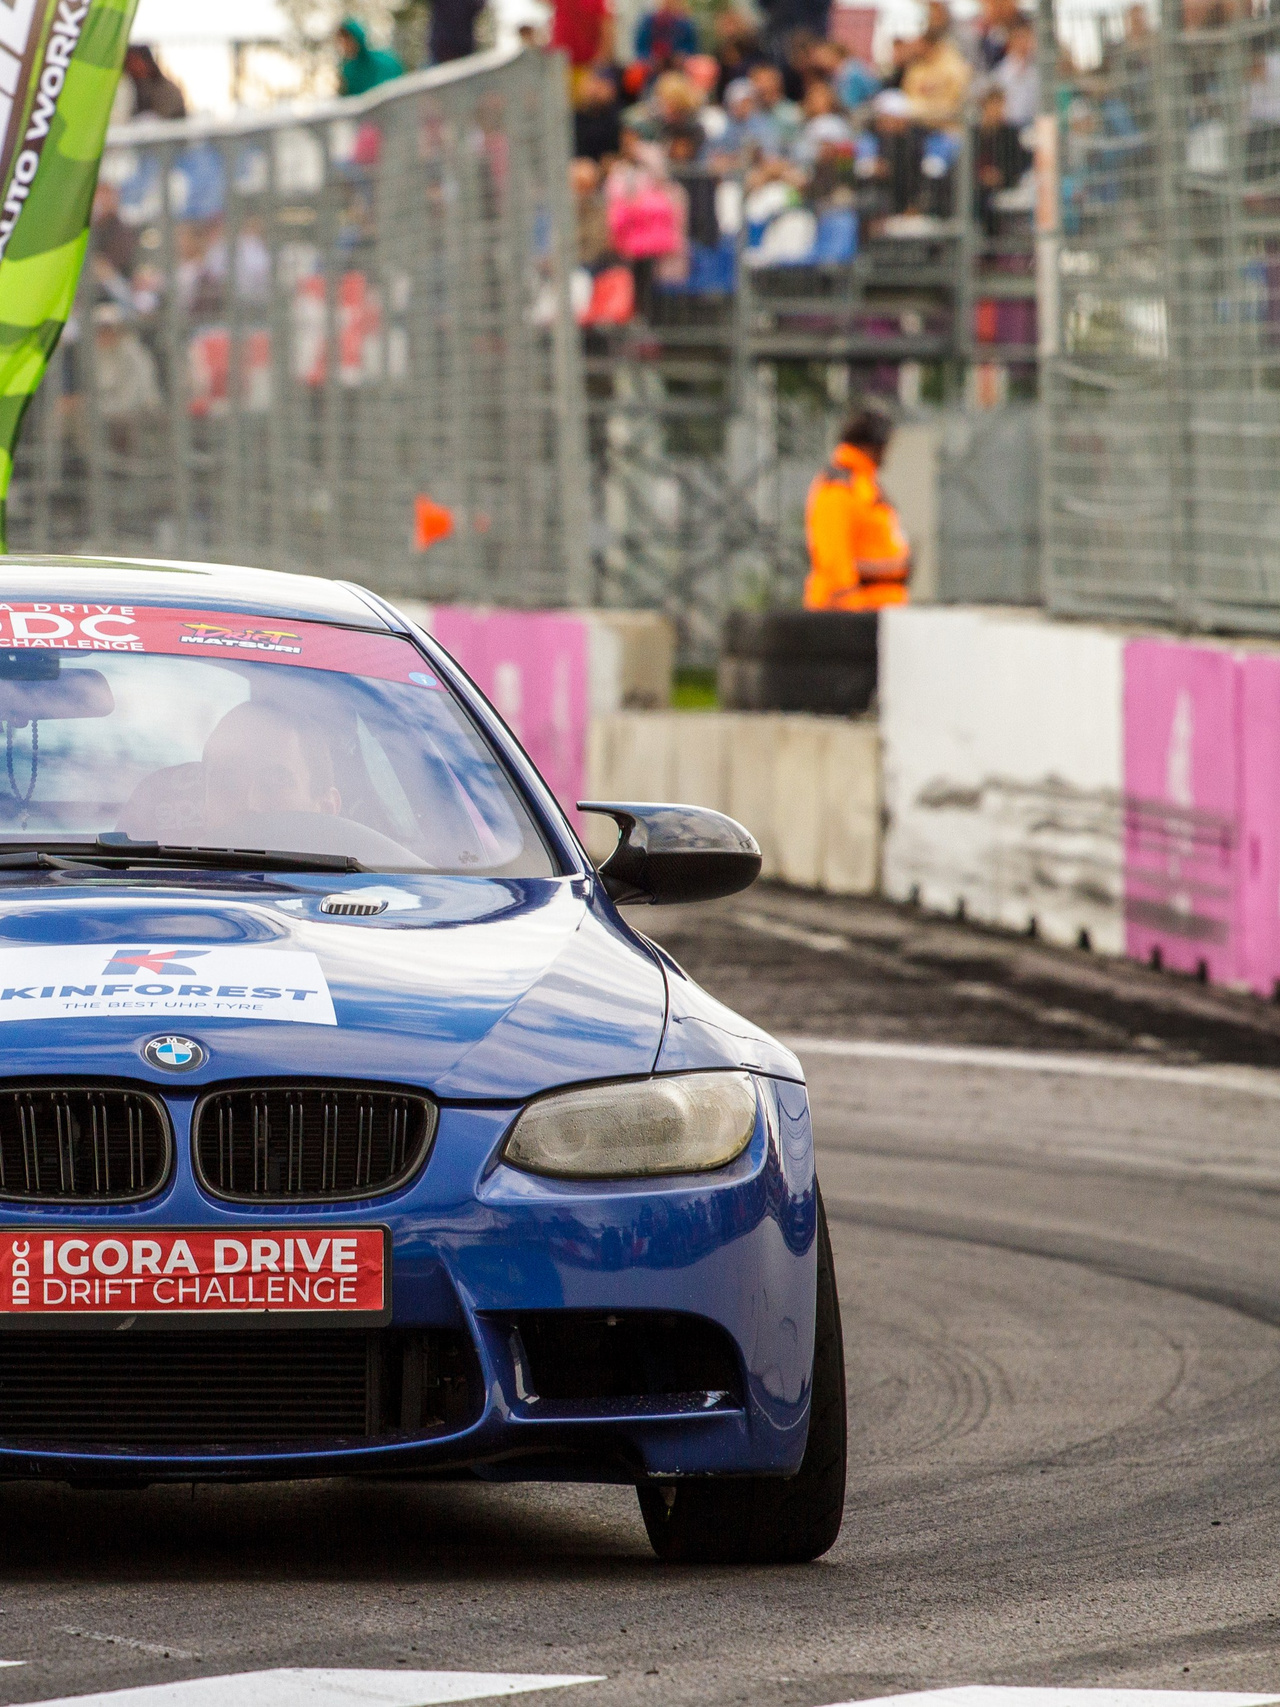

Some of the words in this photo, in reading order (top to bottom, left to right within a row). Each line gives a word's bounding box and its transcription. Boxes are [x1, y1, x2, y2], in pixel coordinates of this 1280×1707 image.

[34, 604, 135, 616] DRIVE
[3, 638, 145, 651] CHALLENGE
[181, 636, 301, 653] MATSURI
[0, 984, 318, 1001] KINFOREST
[63, 1002, 101, 1011] THE
[108, 1001, 156, 1009] BEST
[164, 1001, 209, 1010] UHP
[213, 1002, 264, 1012] TYRE
[150, 1036, 197, 1050] BMW
[43, 1238, 199, 1275] IGORA
[214, 1238, 358, 1273] DRIVE
[12, 1240, 30, 1305] IDDC
[43, 1278, 144, 1305] DRIFT
[152, 1276, 357, 1303] CHALLENGE
